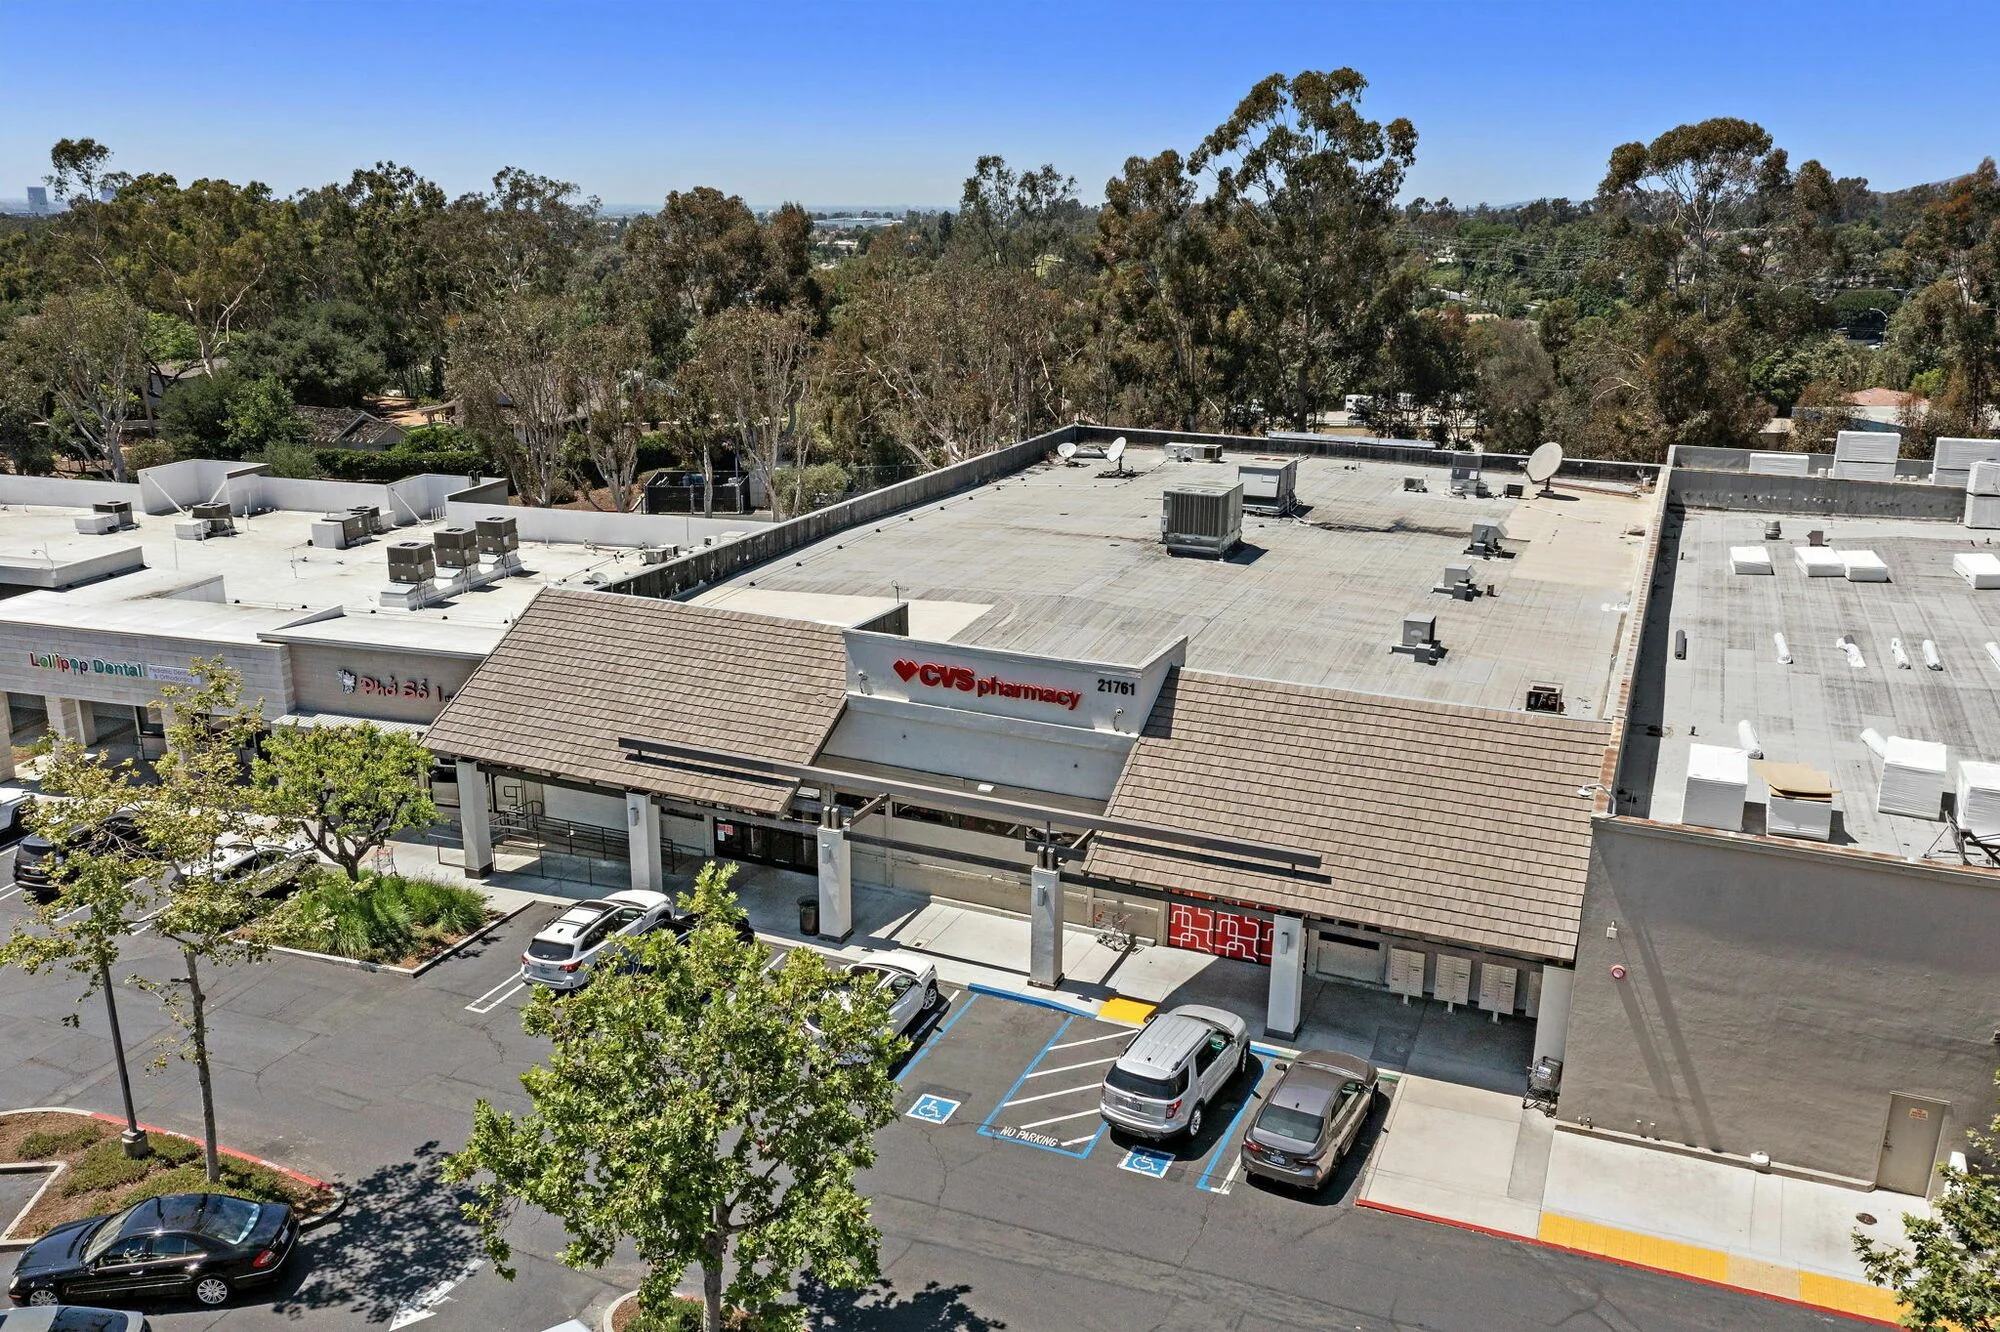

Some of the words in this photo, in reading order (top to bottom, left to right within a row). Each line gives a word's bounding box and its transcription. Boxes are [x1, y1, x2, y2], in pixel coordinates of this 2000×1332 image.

[29, 652, 88, 675] Lollipop
[93, 659, 144, 677] Dental
[919, 663, 976, 692] CVS
[978, 676, 1082, 711] pharmacy
[1097, 679, 1135, 697] 21761
[1000, 1126, 1016, 1137] NO
[1017, 1130, 1058, 1147] PARKING
